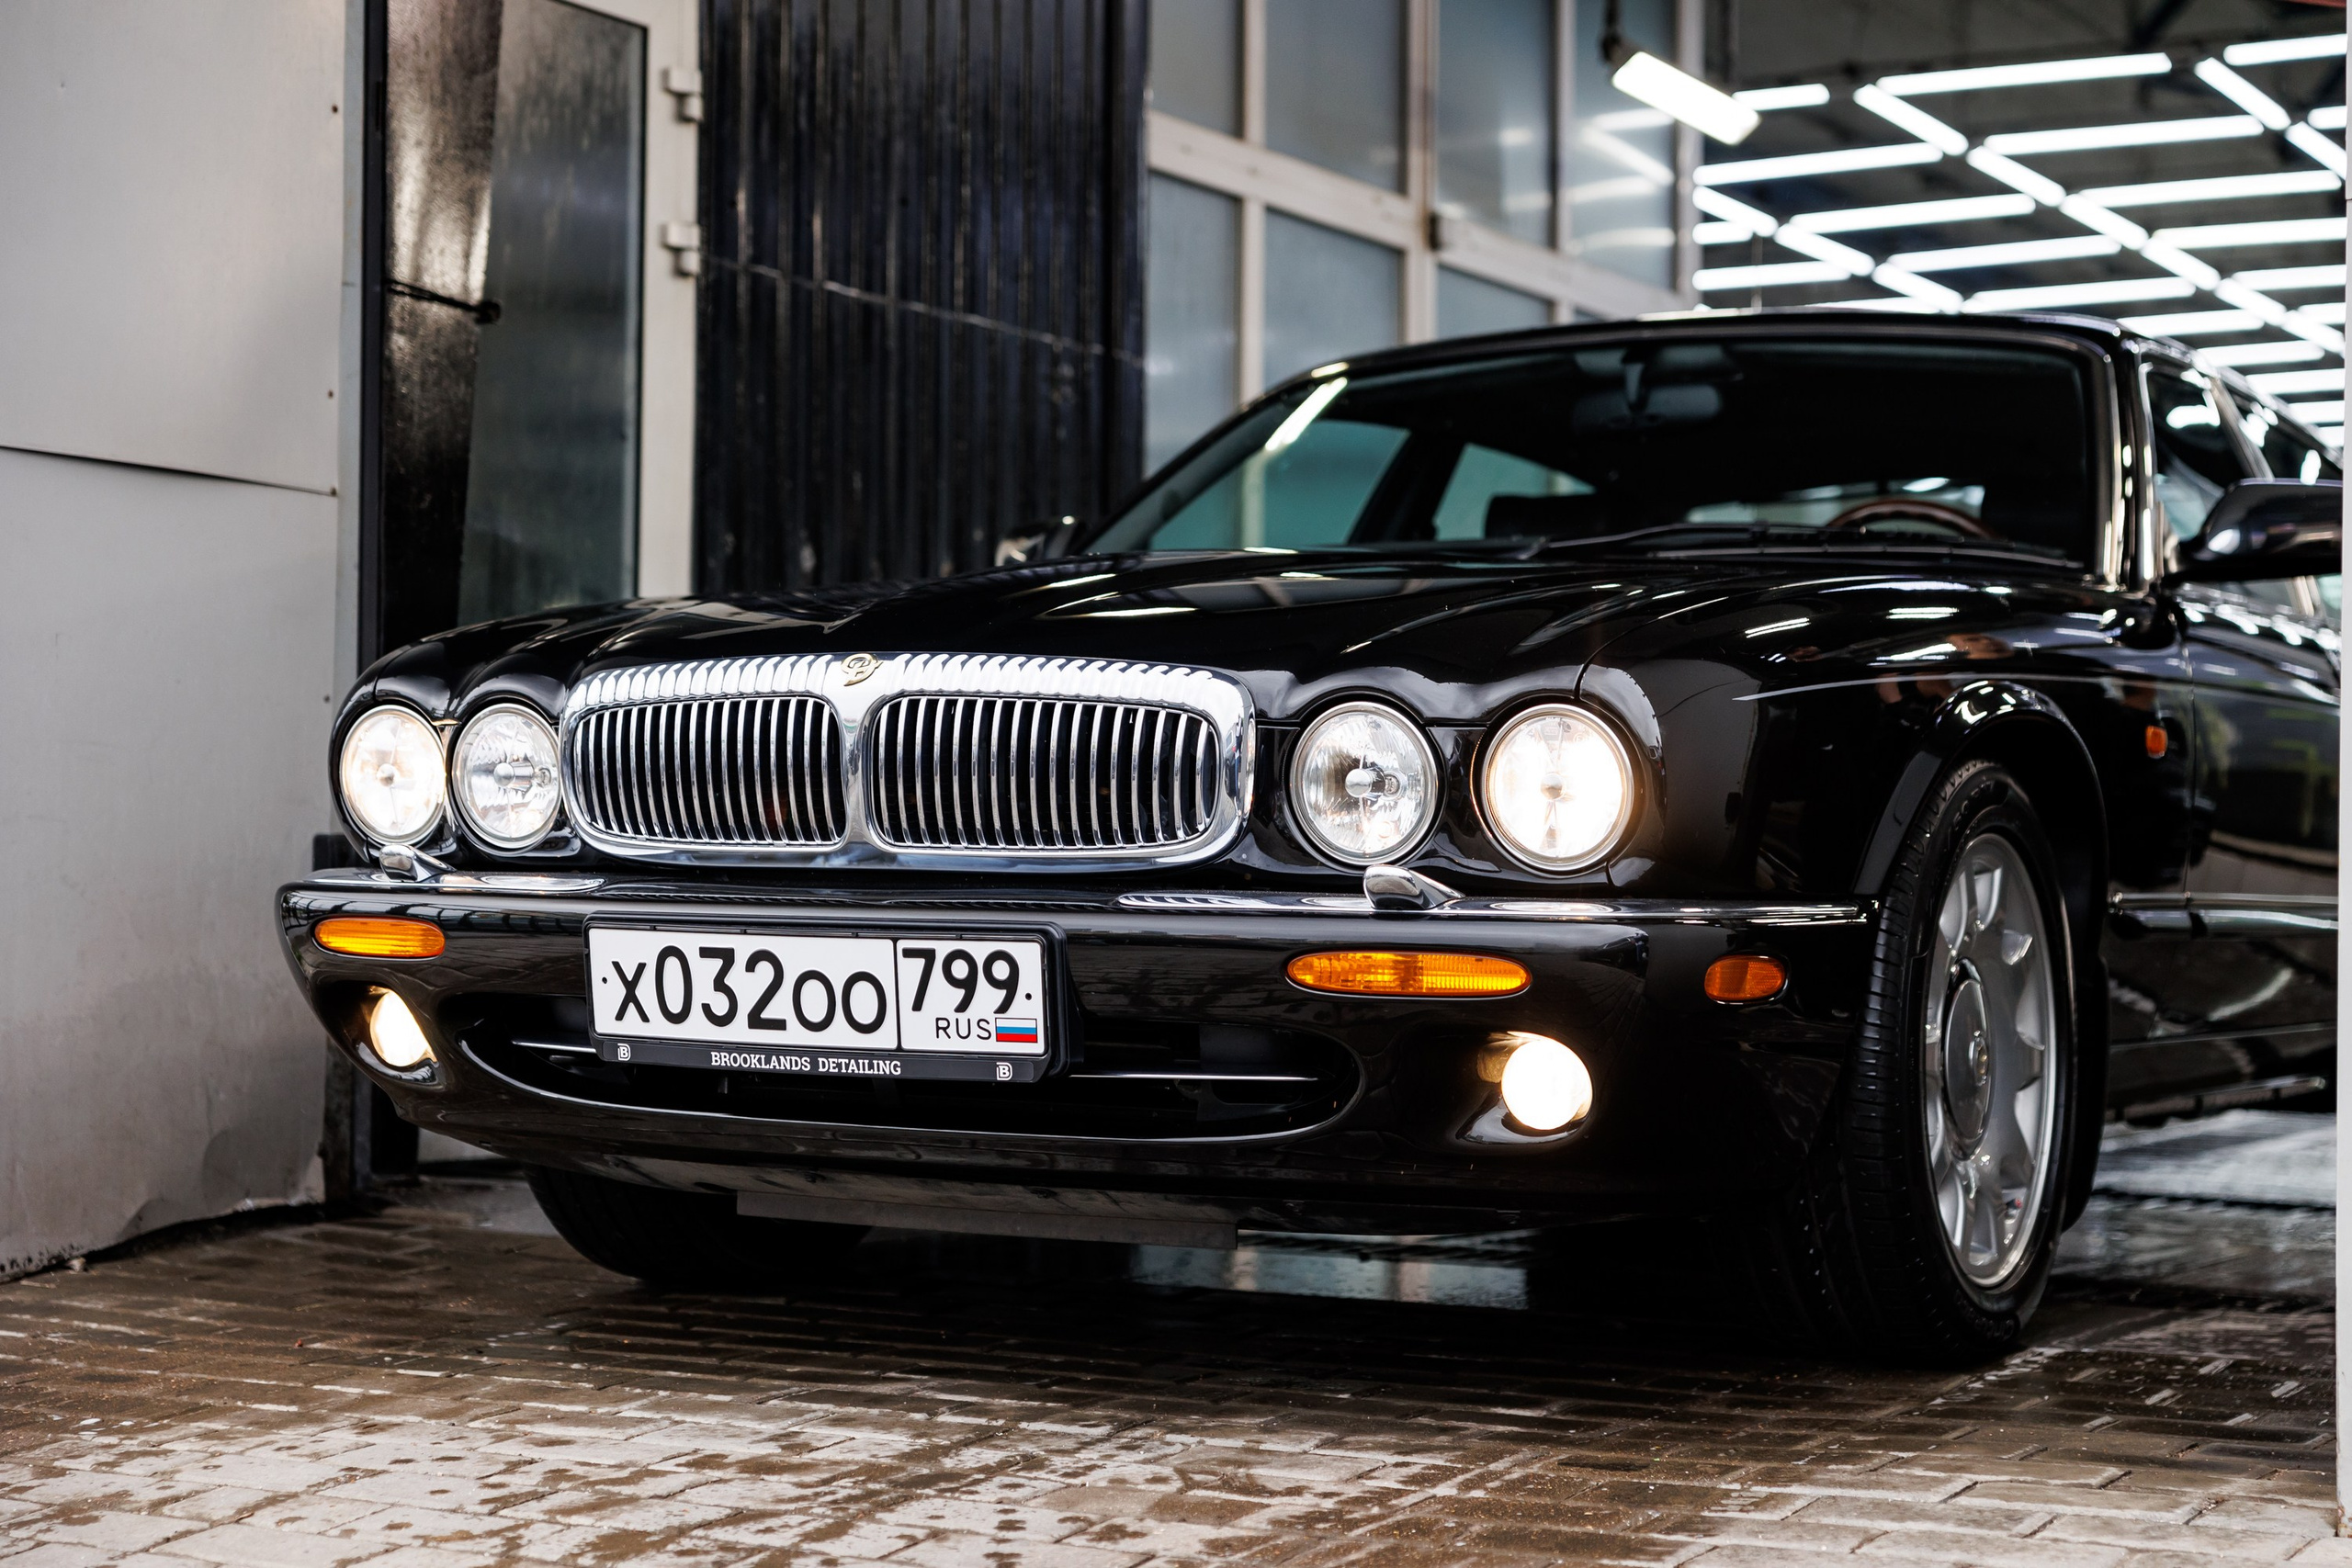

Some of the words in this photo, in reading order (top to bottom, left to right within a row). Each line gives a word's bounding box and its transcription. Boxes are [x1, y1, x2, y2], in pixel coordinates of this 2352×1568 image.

[901, 947, 1020, 1015] 799
[935, 1017, 992, 1041] RUS
[710, 1051, 811, 1072] BROOKLANDS
[817, 1057, 902, 1076] DETAILING
